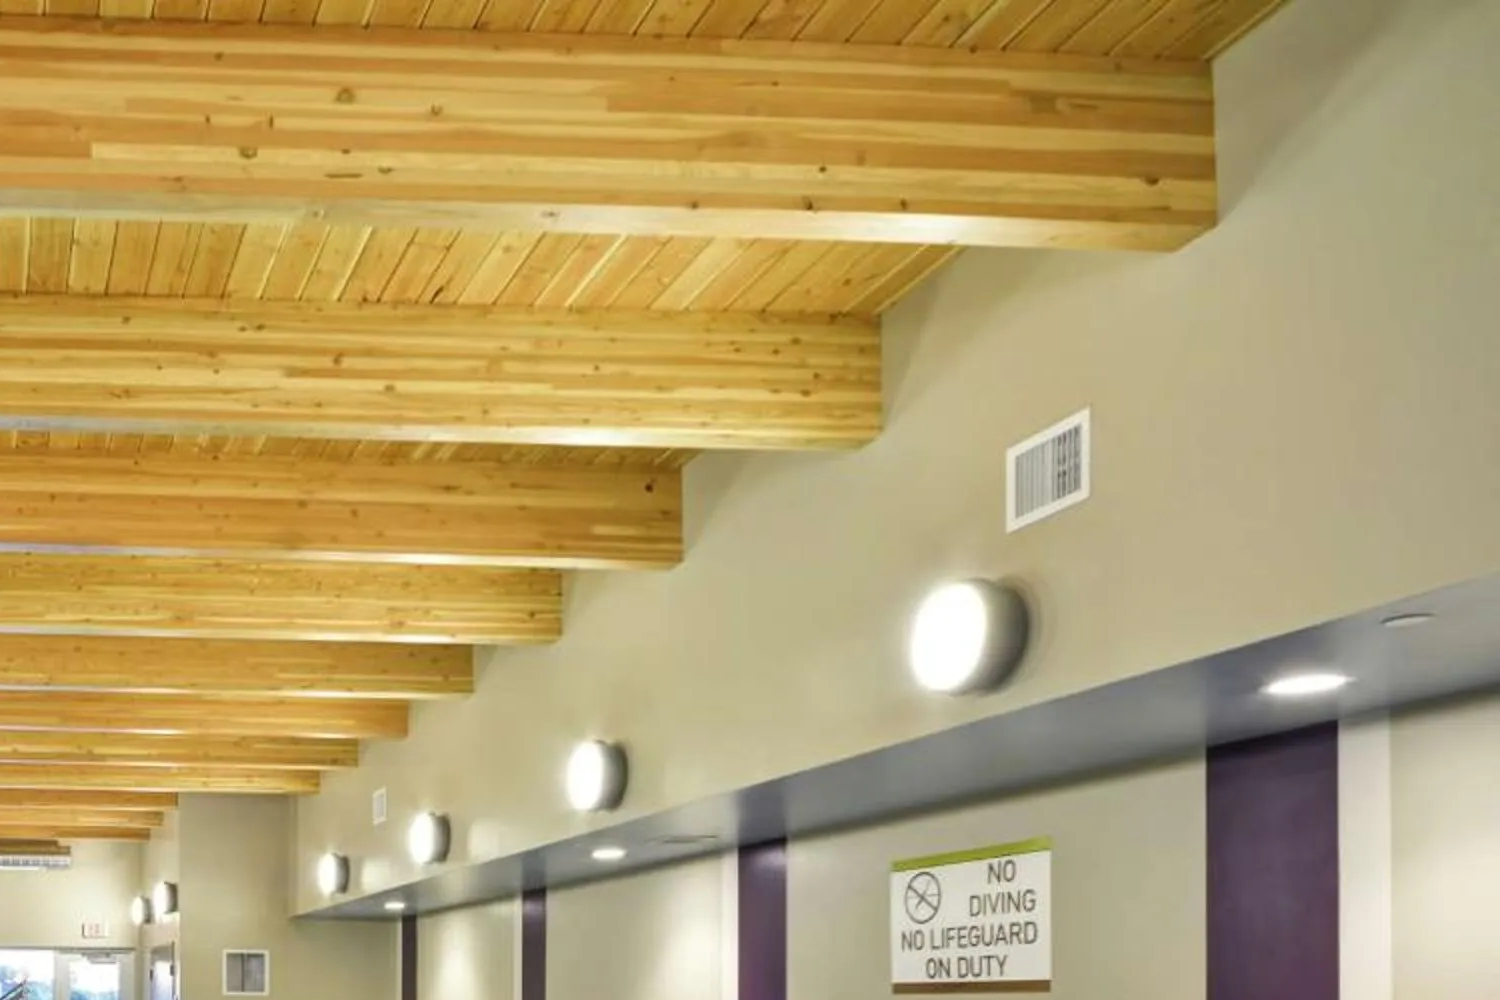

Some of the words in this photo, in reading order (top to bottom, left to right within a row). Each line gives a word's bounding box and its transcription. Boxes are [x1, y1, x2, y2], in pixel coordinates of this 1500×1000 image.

[987, 859, 1017, 884] NO
[969, 889, 1037, 917] DIVING
[901, 929, 925, 952] NO
[930, 921, 1038, 950] LIFEGUARD
[926, 957, 951, 979] ON
[957, 955, 1008, 978] DUTY
